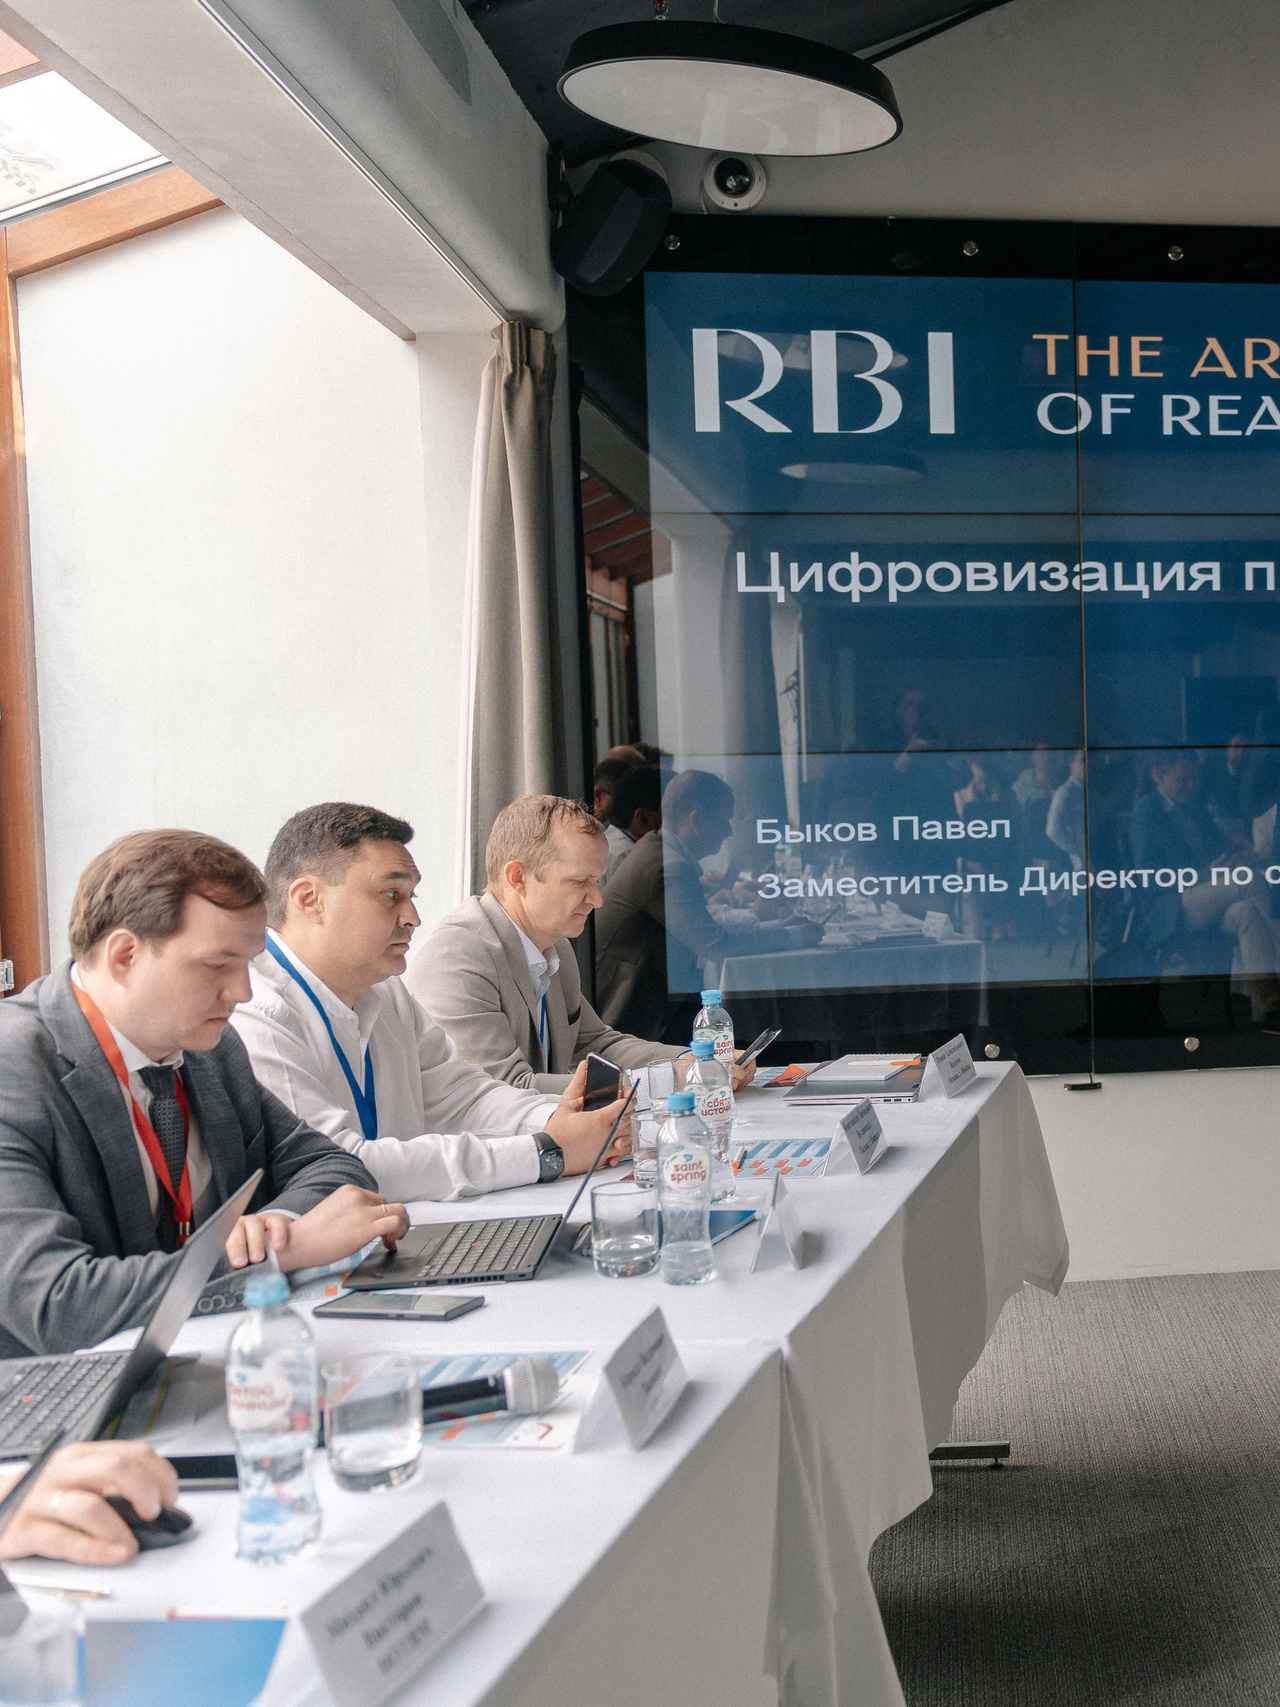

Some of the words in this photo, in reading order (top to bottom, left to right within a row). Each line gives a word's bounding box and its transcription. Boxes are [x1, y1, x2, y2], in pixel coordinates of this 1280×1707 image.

[1032, 334, 1164, 378] THE
[692, 328, 956, 435] RBI
[1036, 392, 1135, 435] OF
[736, 551, 1221, 603] Цифровизация
[756, 818, 879, 844] Быков
[892, 815, 1011, 841] Павел
[756, 872, 1009, 899] Заместитель
[1019, 866, 1199, 897] Директор
[1211, 866, 1253, 886] по
[670, 1169, 707, 1184] spring
[673, 1160, 703, 1172] saint
